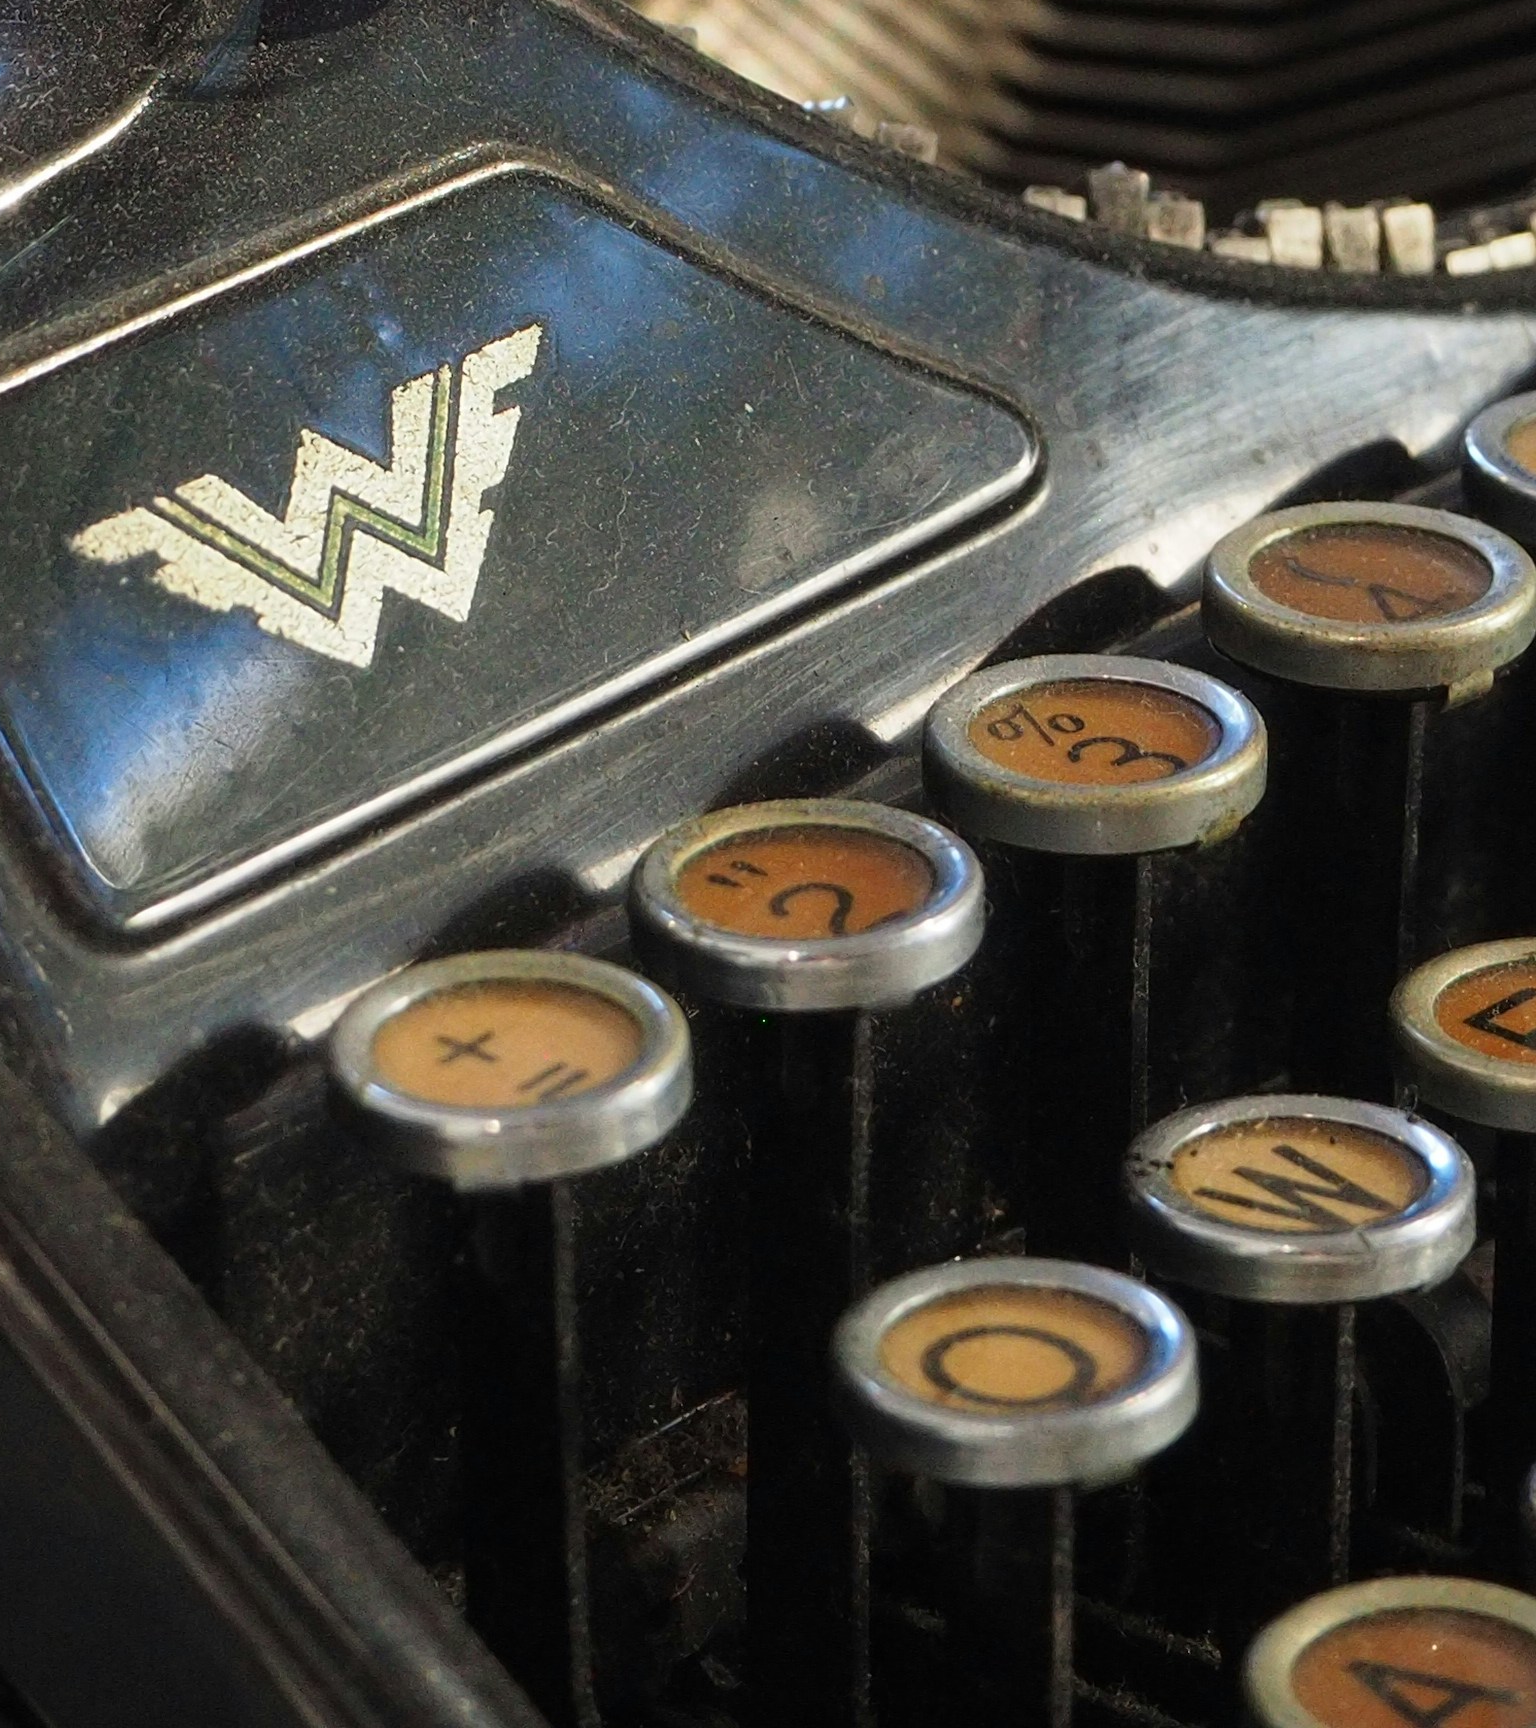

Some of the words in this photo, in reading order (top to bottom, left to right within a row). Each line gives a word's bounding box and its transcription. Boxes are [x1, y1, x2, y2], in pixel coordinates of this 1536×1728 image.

[1067, 736, 1188, 772] 3
[1192, 1143, 1402, 1228] W
[1344, 1658, 1526, 1728] A
